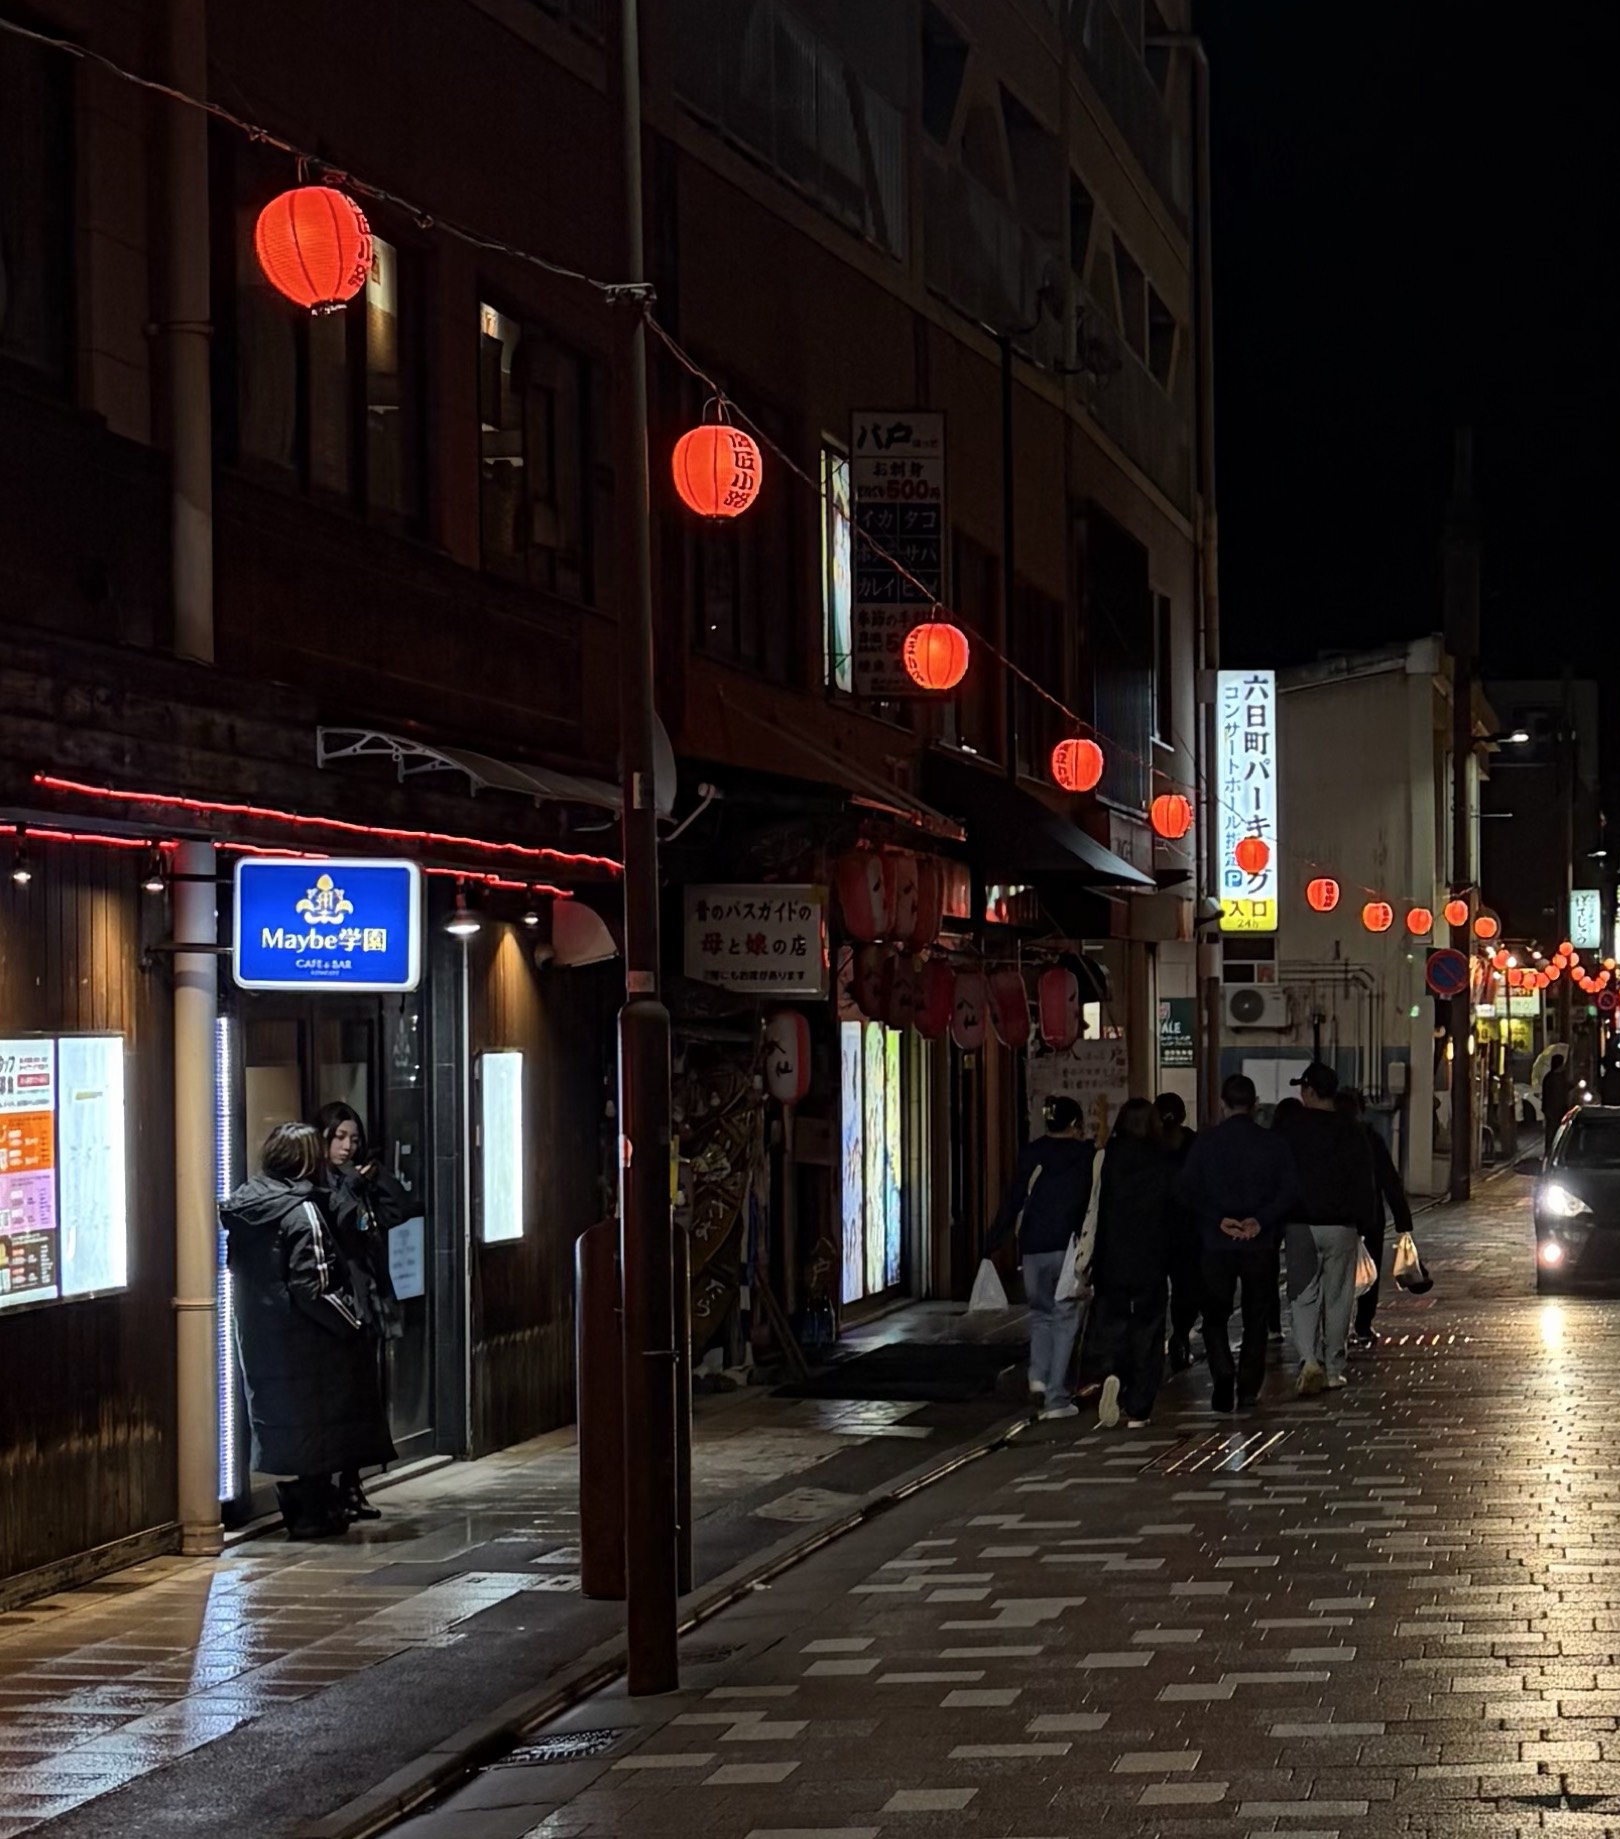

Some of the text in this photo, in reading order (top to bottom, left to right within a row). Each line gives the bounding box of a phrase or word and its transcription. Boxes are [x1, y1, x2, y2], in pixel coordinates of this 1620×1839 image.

[857, 422, 913, 449] 八戸
[905, 510, 937, 529] タコ
[858, 577, 895, 597] カレイ
[1244, 675, 1271, 894] 六日町パーキグ
[697, 900, 812, 921] 昔のバスガイドの
[1229, 901, 1266, 917] 入口
[262, 927, 387, 953] Maybe学園
[702, 932, 806, 956] 母と娘の店
[296, 959, 322, 969] CAFE
[332, 959, 352, 969] BAR
